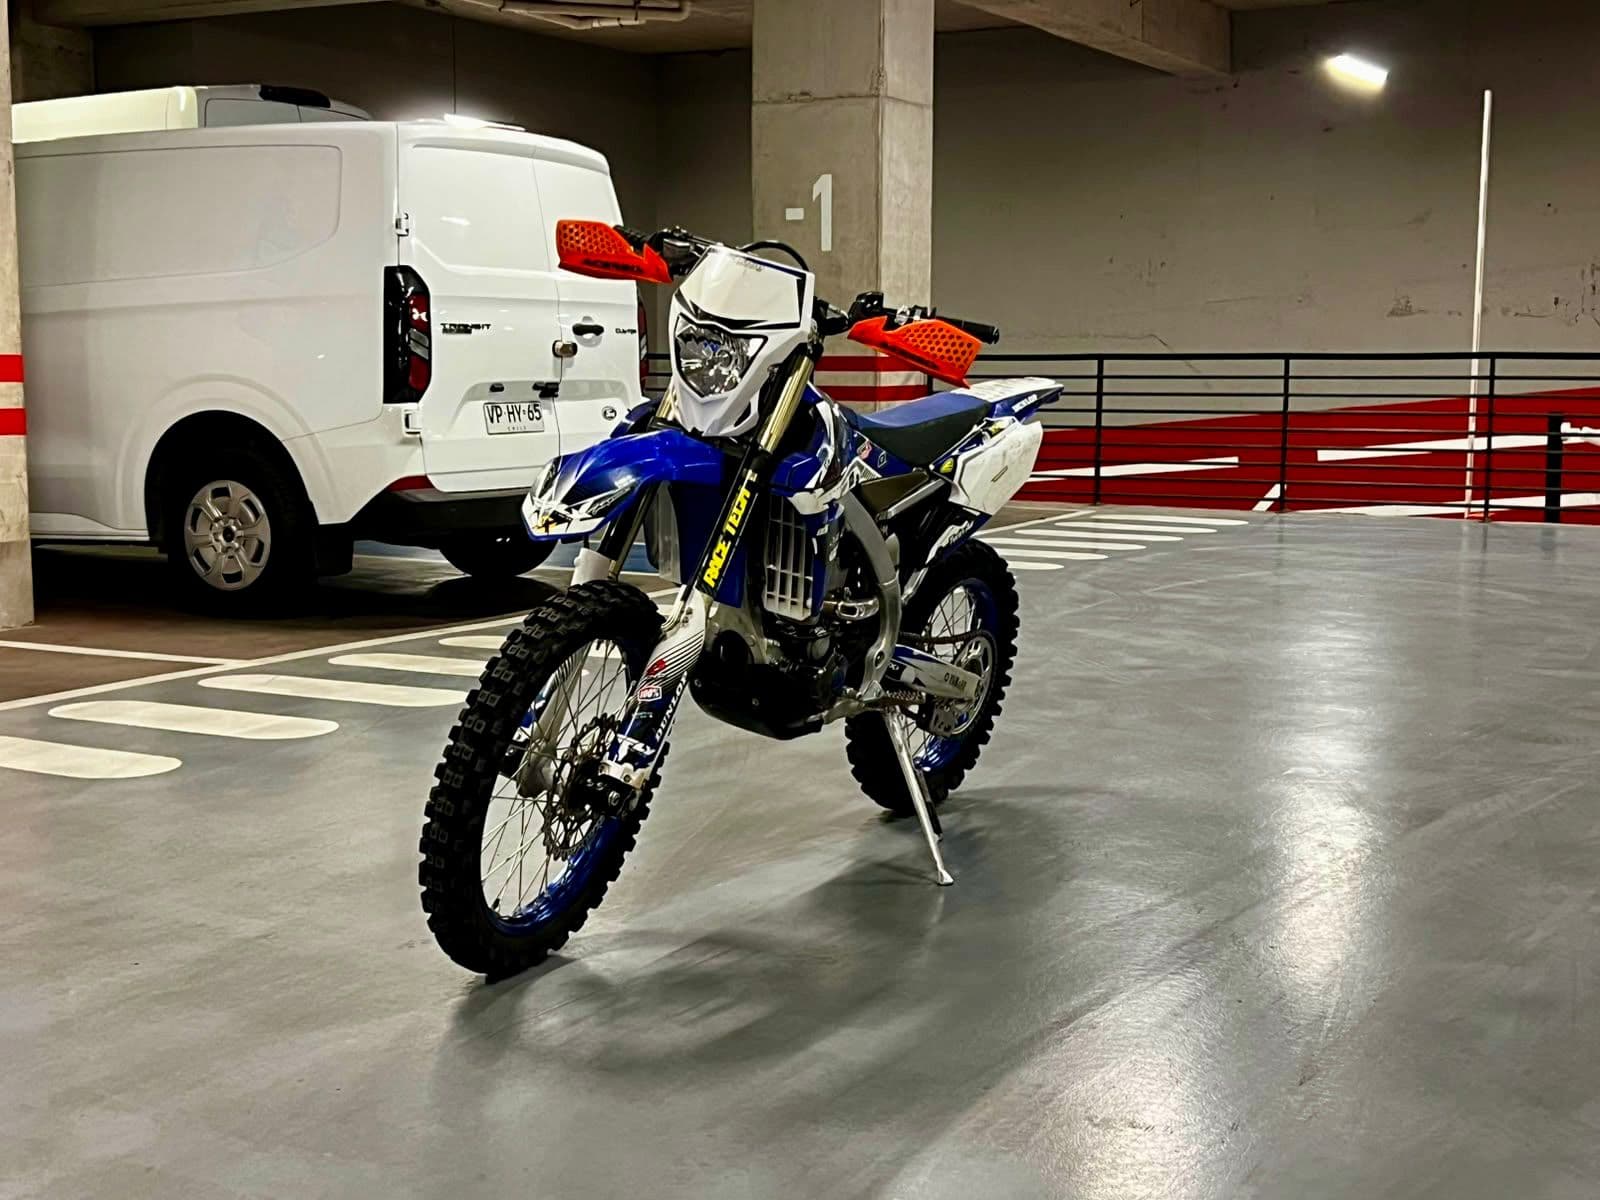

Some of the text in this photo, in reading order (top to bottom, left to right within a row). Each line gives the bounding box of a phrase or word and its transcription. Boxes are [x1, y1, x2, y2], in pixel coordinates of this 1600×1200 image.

[785, 173, 833, 252] -1
[703, 534, 731, 588] RACE
[655, 671, 688, 743] DUNLOP
